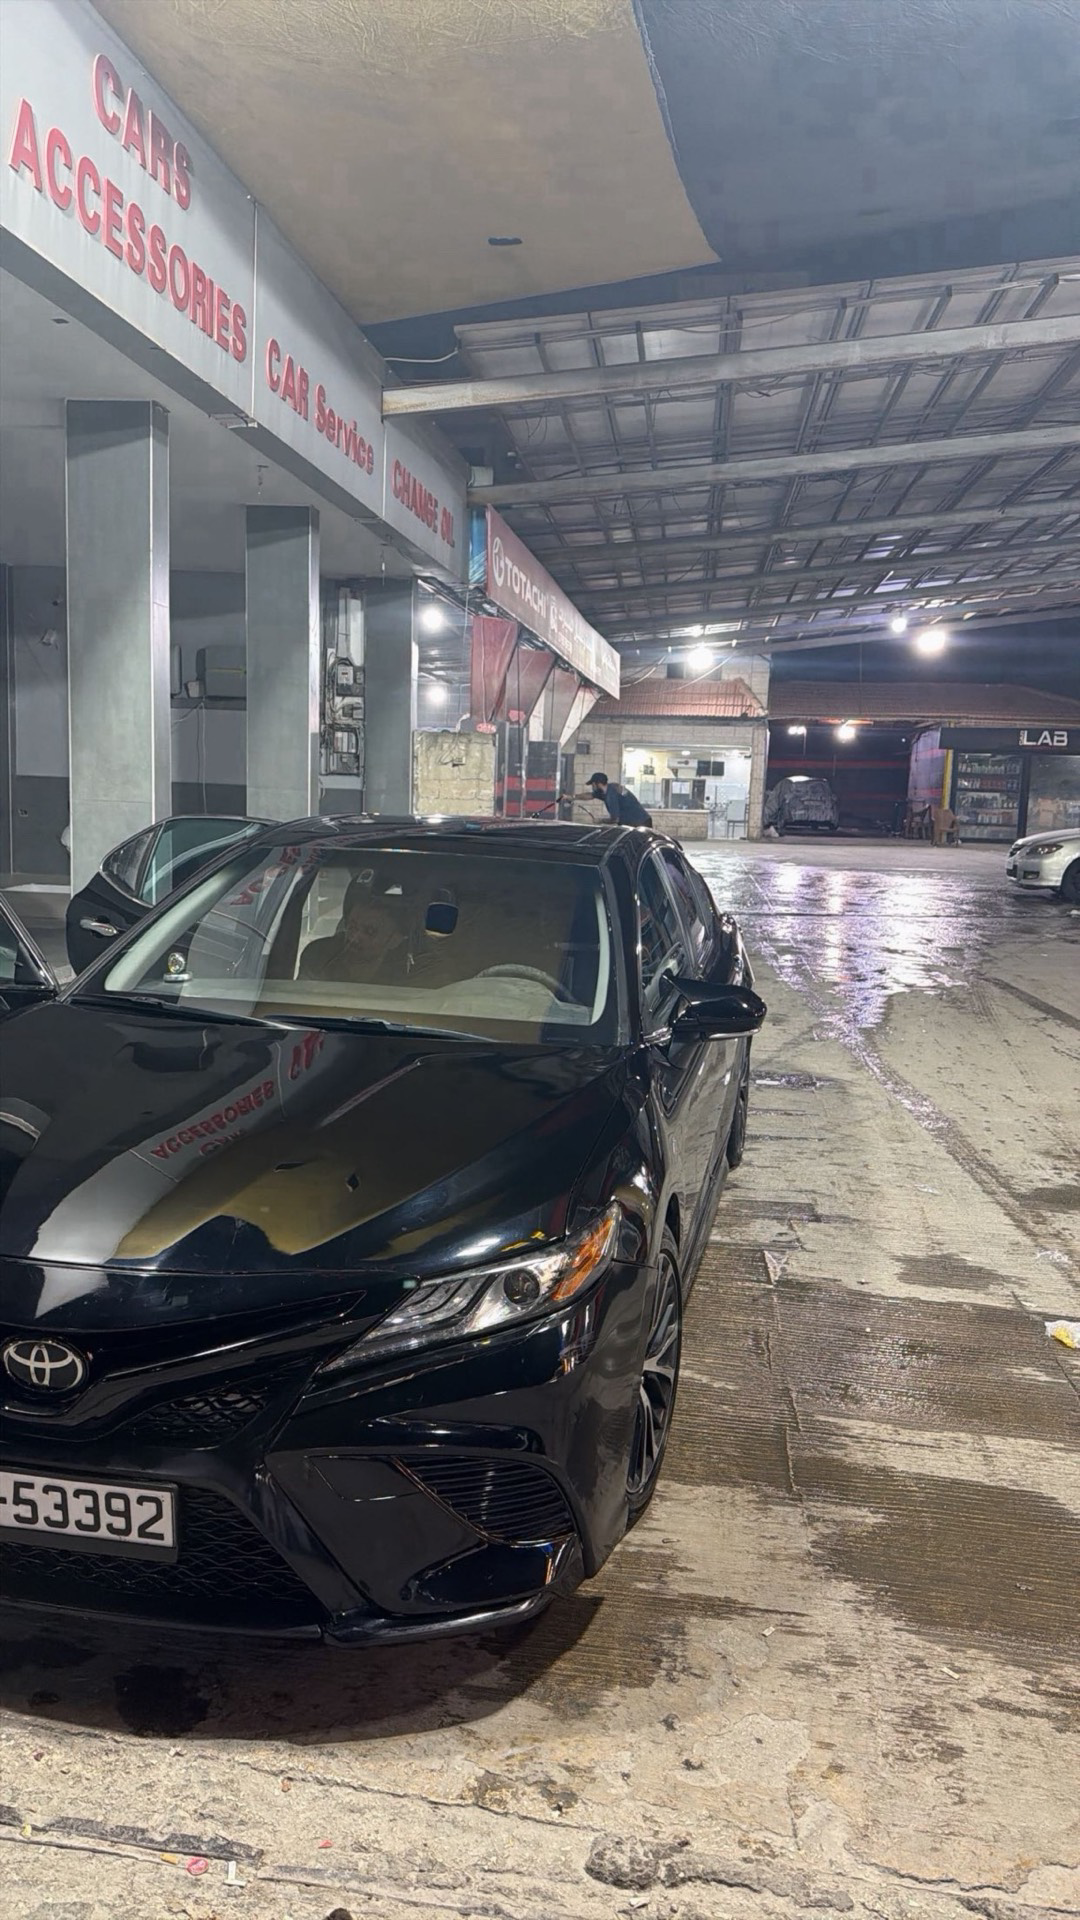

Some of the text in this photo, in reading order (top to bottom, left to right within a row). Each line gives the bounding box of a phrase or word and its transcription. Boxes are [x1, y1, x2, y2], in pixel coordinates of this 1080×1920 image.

[93, 53, 193, 211] CARS
[8, 97, 248, 363] ACCESSORIES
[266, 337, 375, 476] CAR Service
[391, 459, 456, 548] CHANGE OIL
[505, 556, 547, 619] TOTACHI
[1024, 729, 1068, 747] LAB
